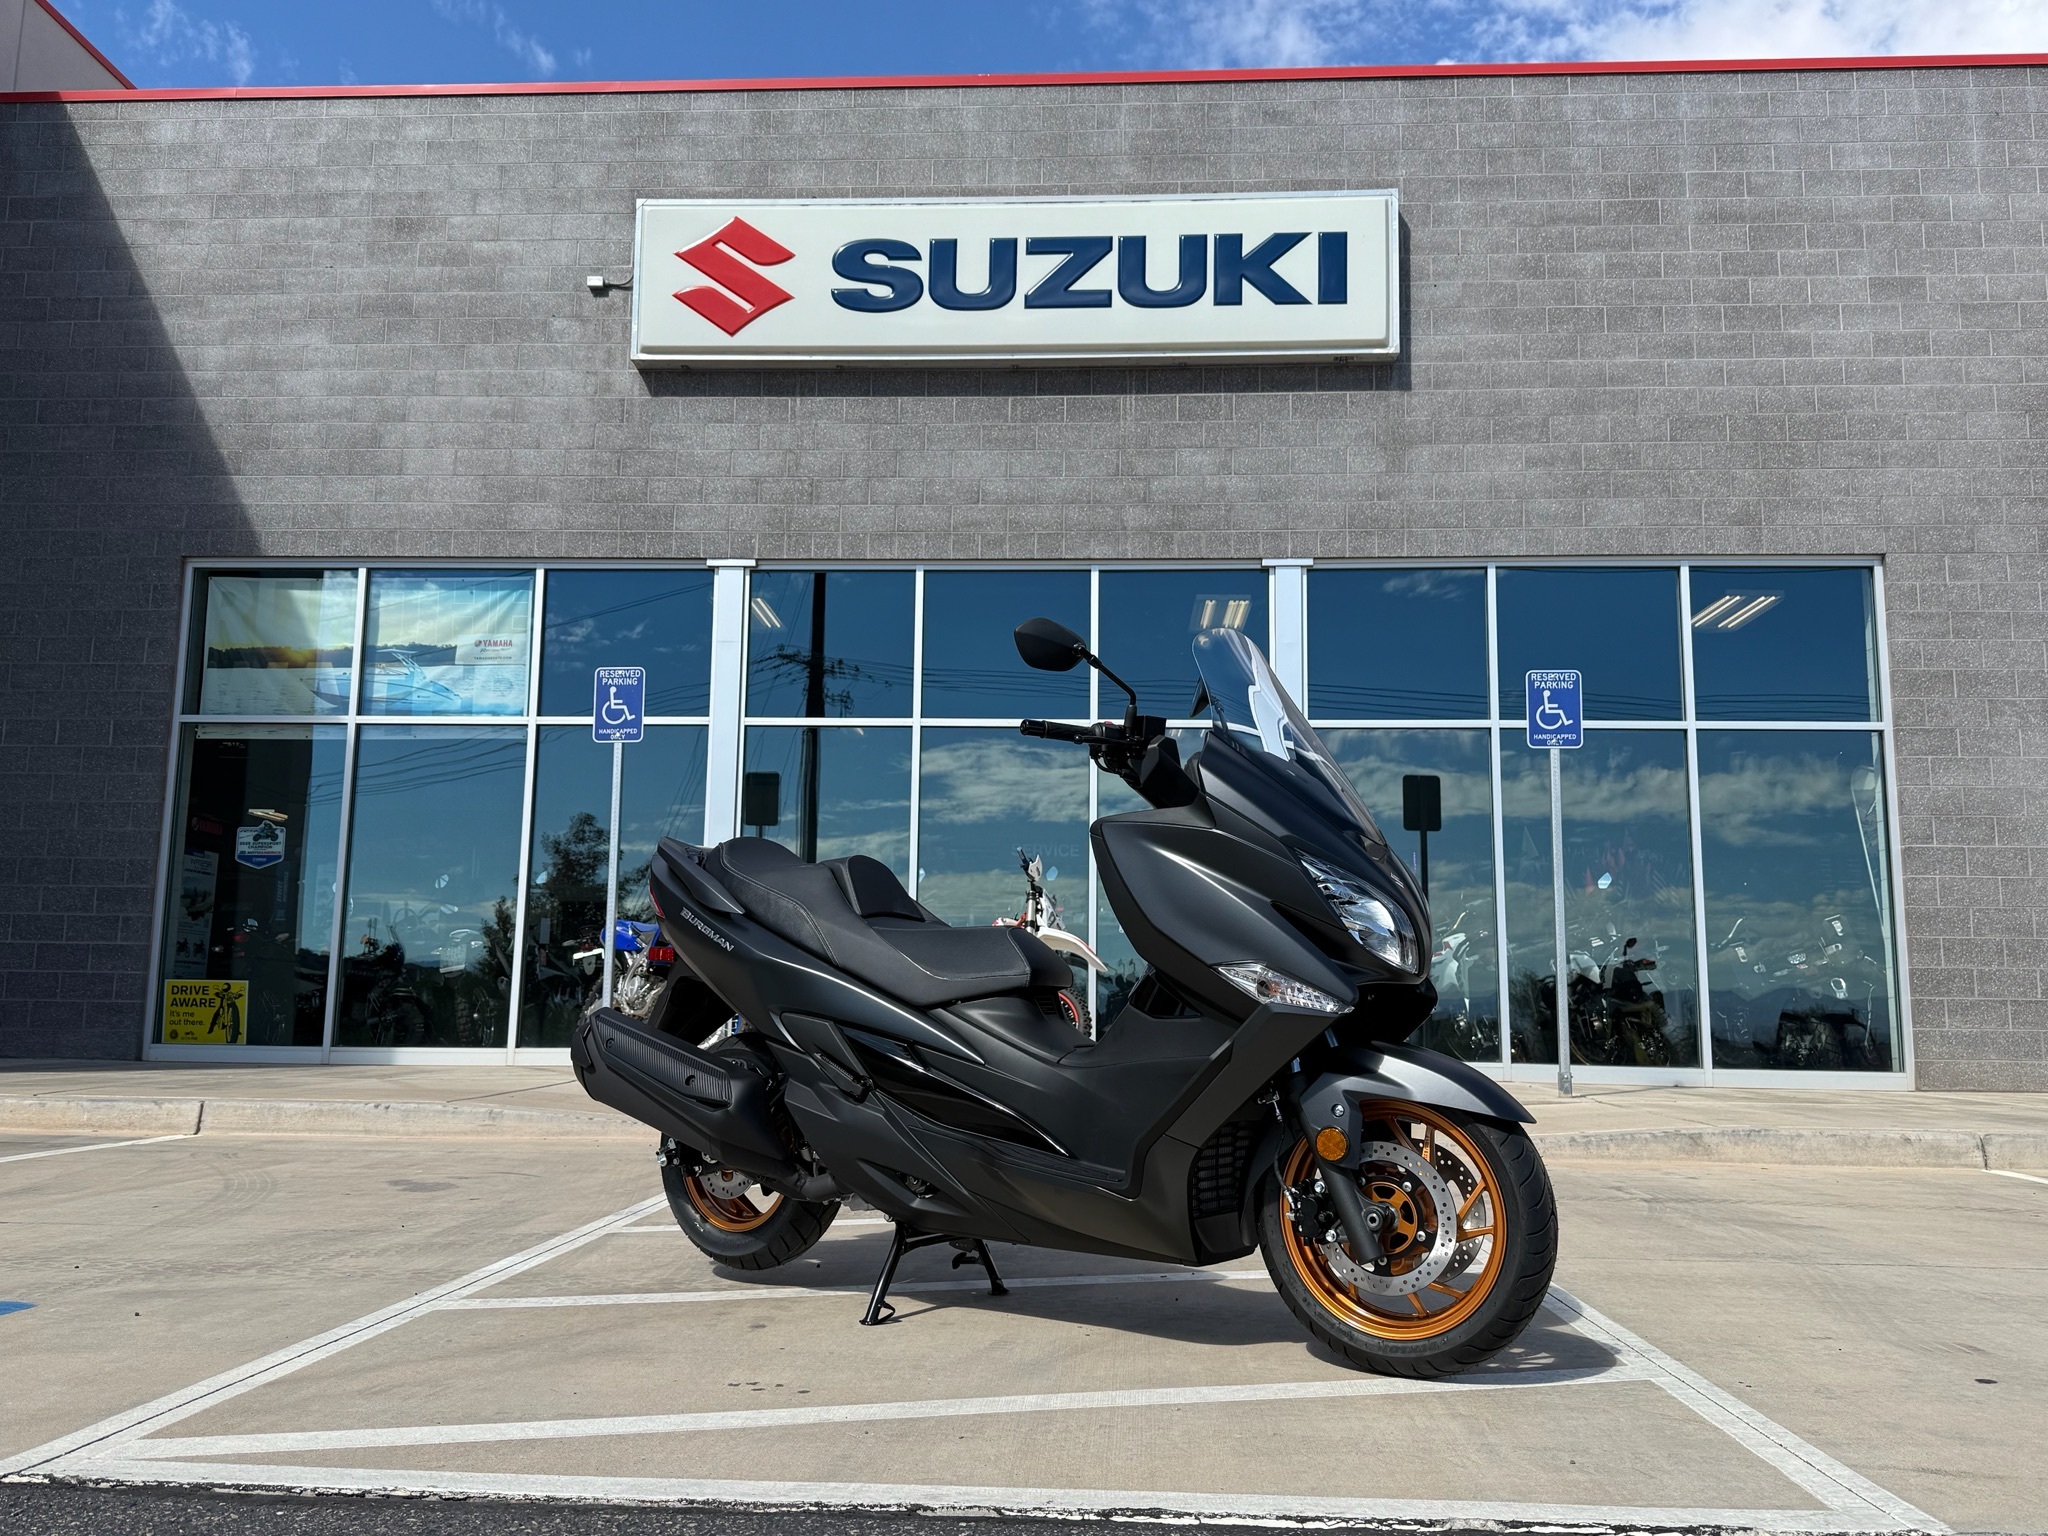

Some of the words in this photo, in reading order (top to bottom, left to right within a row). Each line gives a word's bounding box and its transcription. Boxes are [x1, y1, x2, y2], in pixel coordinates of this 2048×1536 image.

[830, 231, 1349, 312] SUZUKI
[483, 639, 513, 647] YAMAHA
[600, 670, 641, 678] RESERVED
[1531, 673, 1576, 681] RESERVED
[1534, 681, 1574, 689] PARKING
[1011, 844, 1081, 857] SERVICE
[680, 907, 735, 952] BURGMAN
[171, 985, 210, 996] DRIVE
[170, 998, 217, 1008] AWARE
